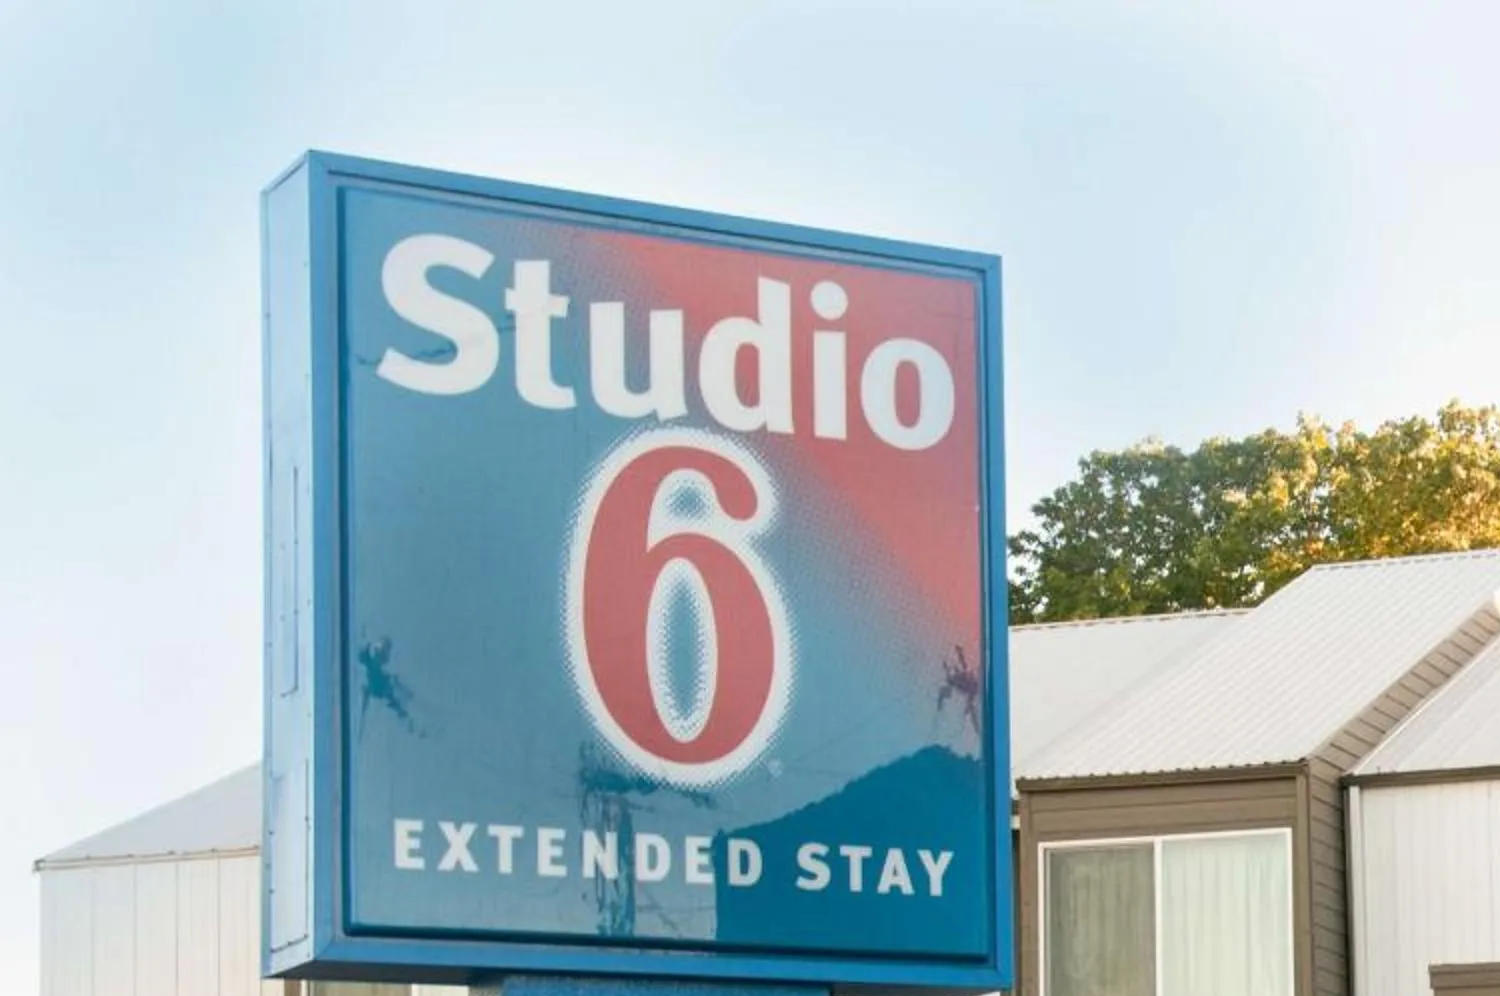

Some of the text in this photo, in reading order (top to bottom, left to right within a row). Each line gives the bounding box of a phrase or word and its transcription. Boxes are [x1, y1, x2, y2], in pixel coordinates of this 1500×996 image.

[377, 234, 955, 450] Studio
[572, 436, 791, 780] 6
[394, 819, 955, 898] EXTENDED STAY
